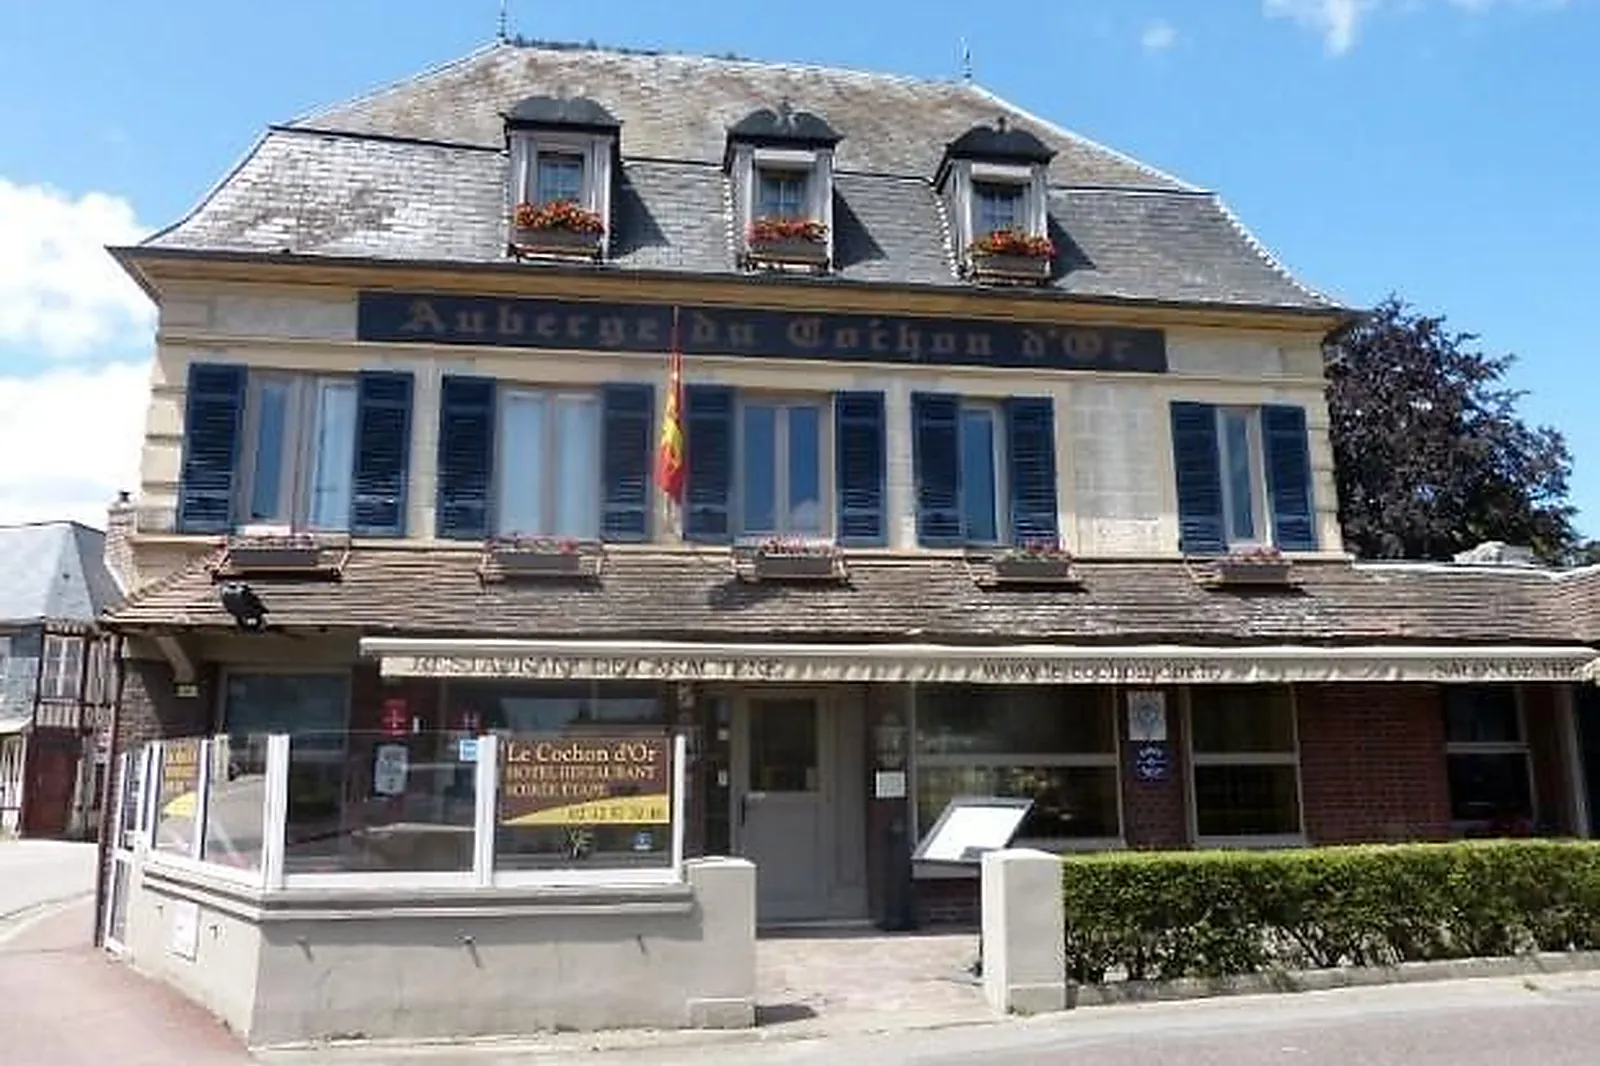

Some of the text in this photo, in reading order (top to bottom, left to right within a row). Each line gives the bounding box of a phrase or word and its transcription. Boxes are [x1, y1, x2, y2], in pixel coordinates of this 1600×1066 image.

[400, 299, 660, 346] Auberge
[691, 311, 758, 347] du
[508, 742, 657, 763] Le Cochon d'Or
